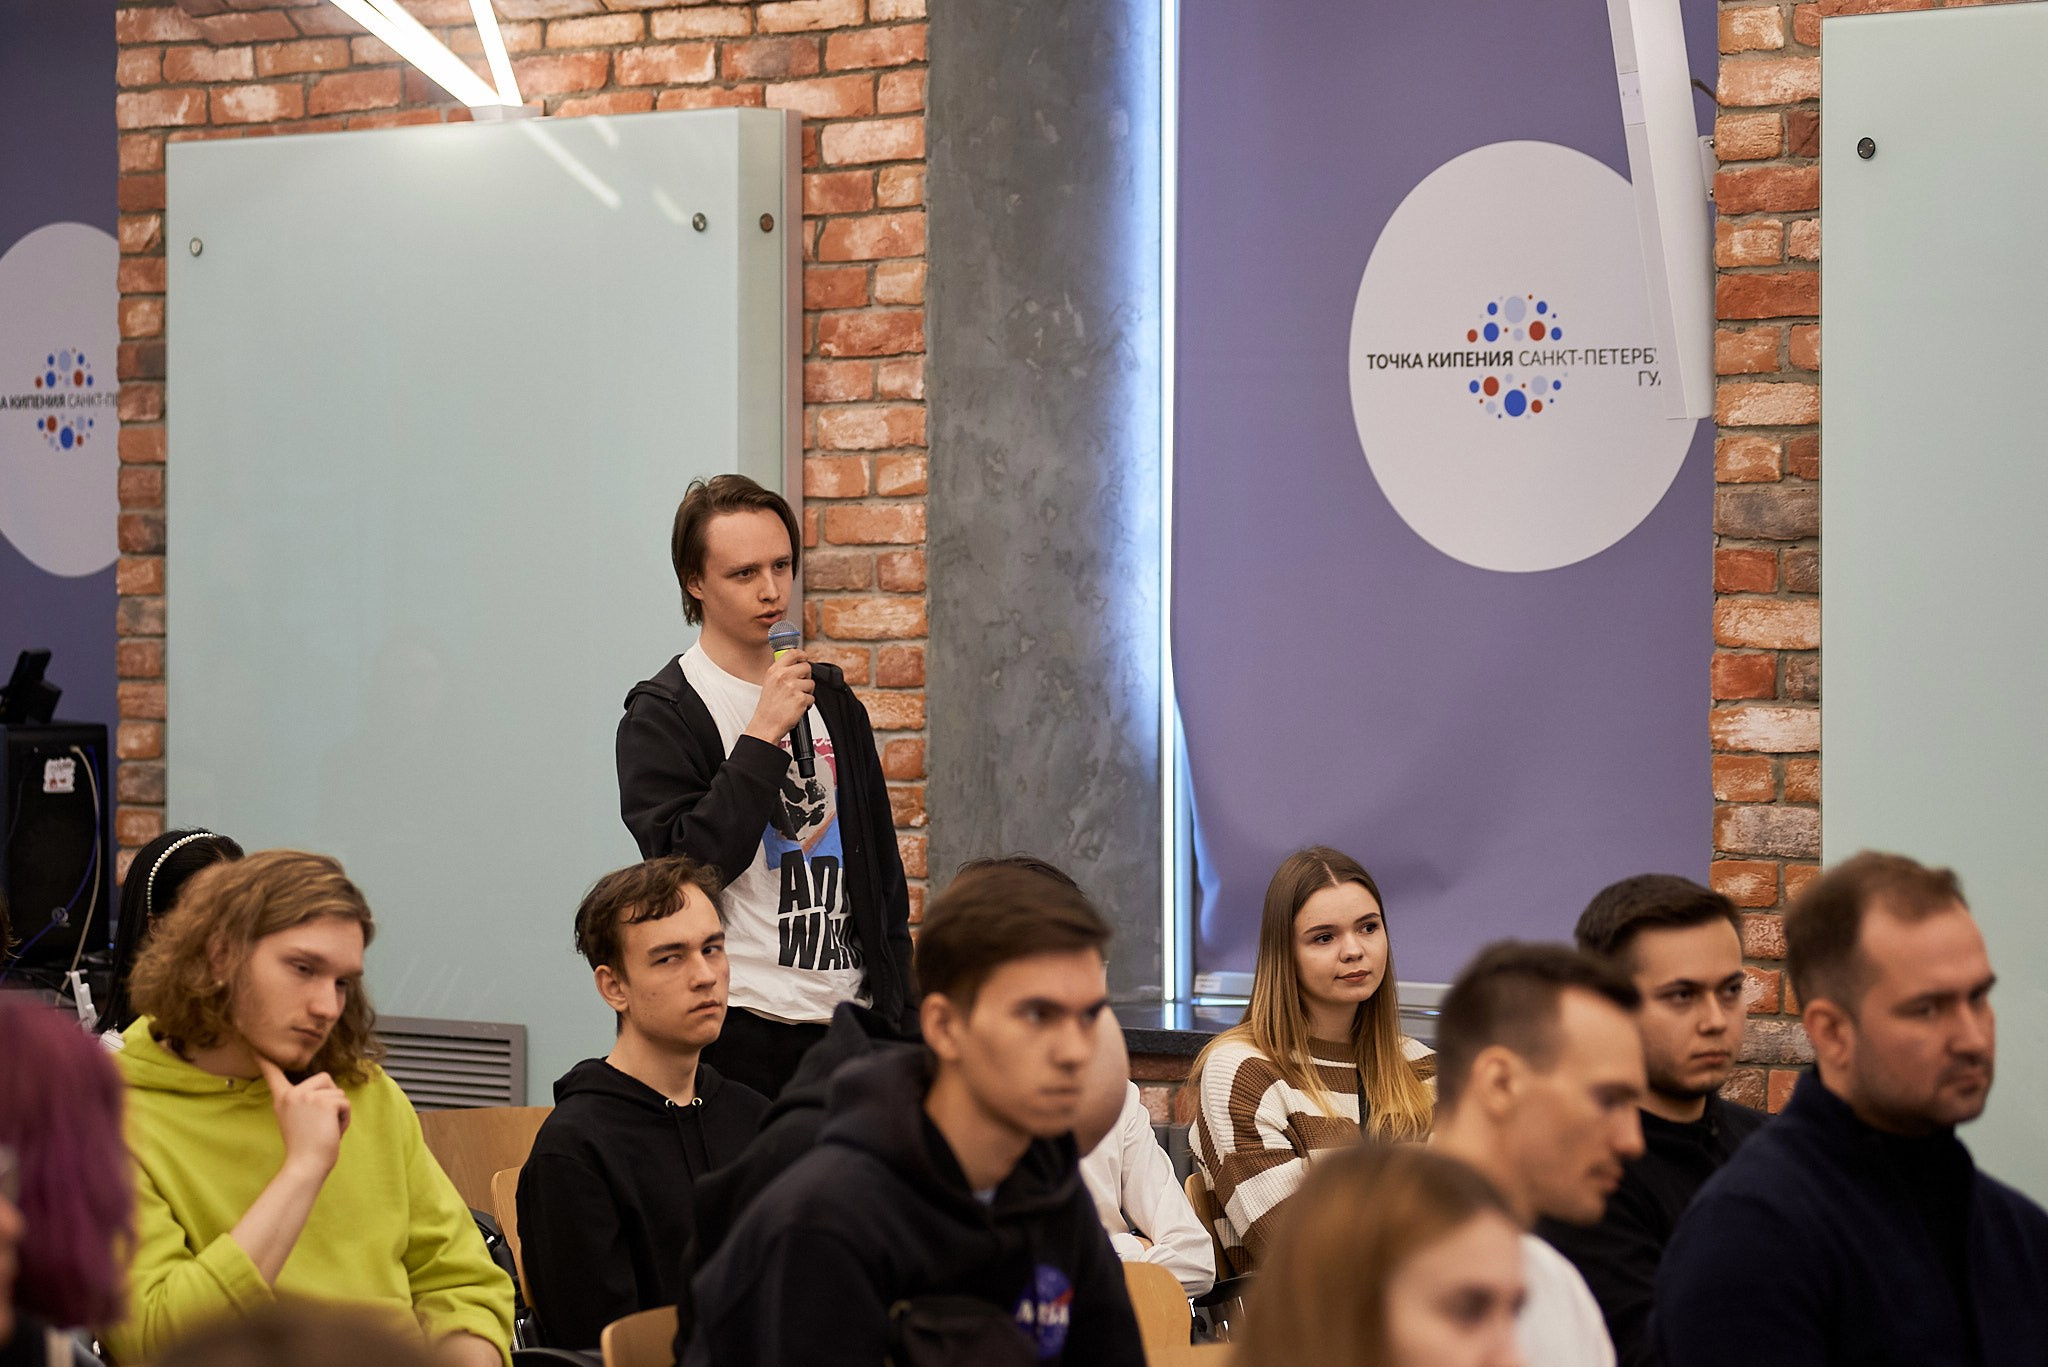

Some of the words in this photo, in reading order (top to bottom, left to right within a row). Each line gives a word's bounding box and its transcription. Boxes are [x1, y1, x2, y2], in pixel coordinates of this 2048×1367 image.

[1367, 353, 1424, 369] ТОЧКА
[1427, 350, 1513, 367] КИПЕНИЯ
[1518, 347, 1658, 366] САНКТ-ПЕТЕРБ
[1638, 370, 1661, 386] ГУ
